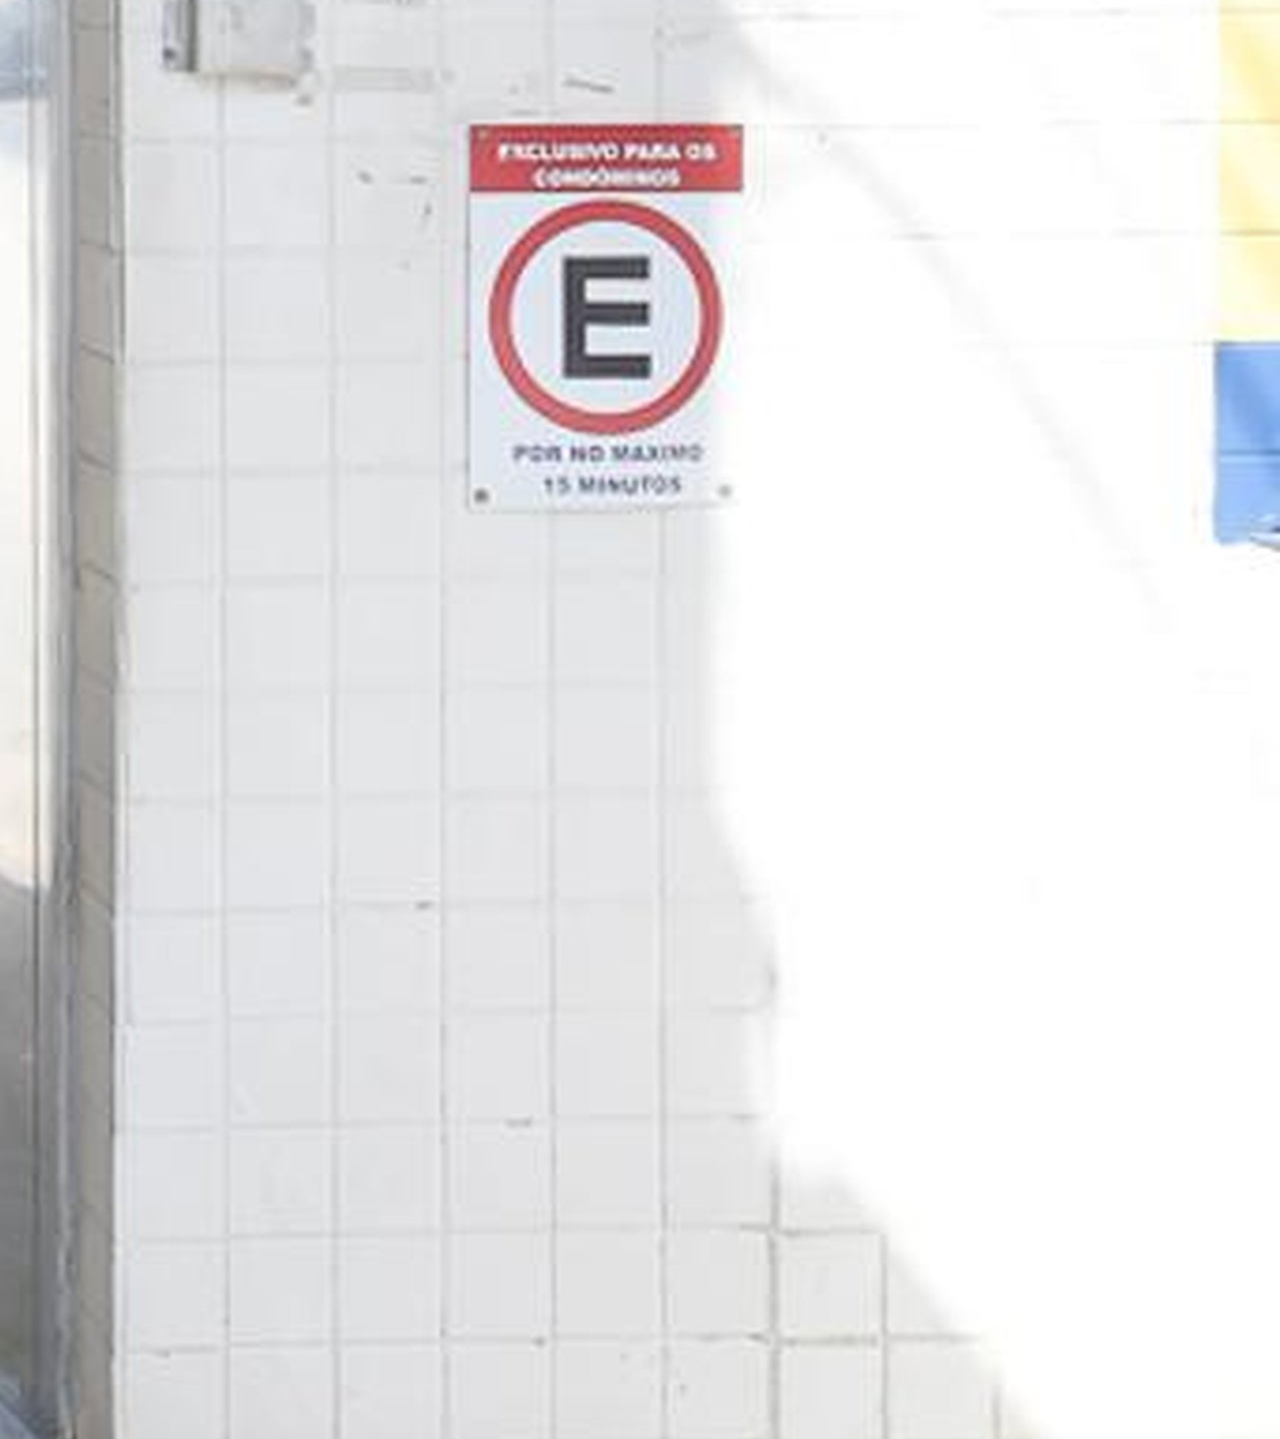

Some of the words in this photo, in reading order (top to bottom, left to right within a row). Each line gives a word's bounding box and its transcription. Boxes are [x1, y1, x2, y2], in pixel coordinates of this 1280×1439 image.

[499, 142, 619, 160] EXCLUSIVO
[623, 143, 681, 160] PARA
[685, 143, 717, 160] OS
[564, 257, 651, 379] E
[513, 445, 562, 462] POR
[570, 445, 605, 462] NO
[544, 477, 570, 494] 15
[578, 477, 681, 495] MINUTOS
